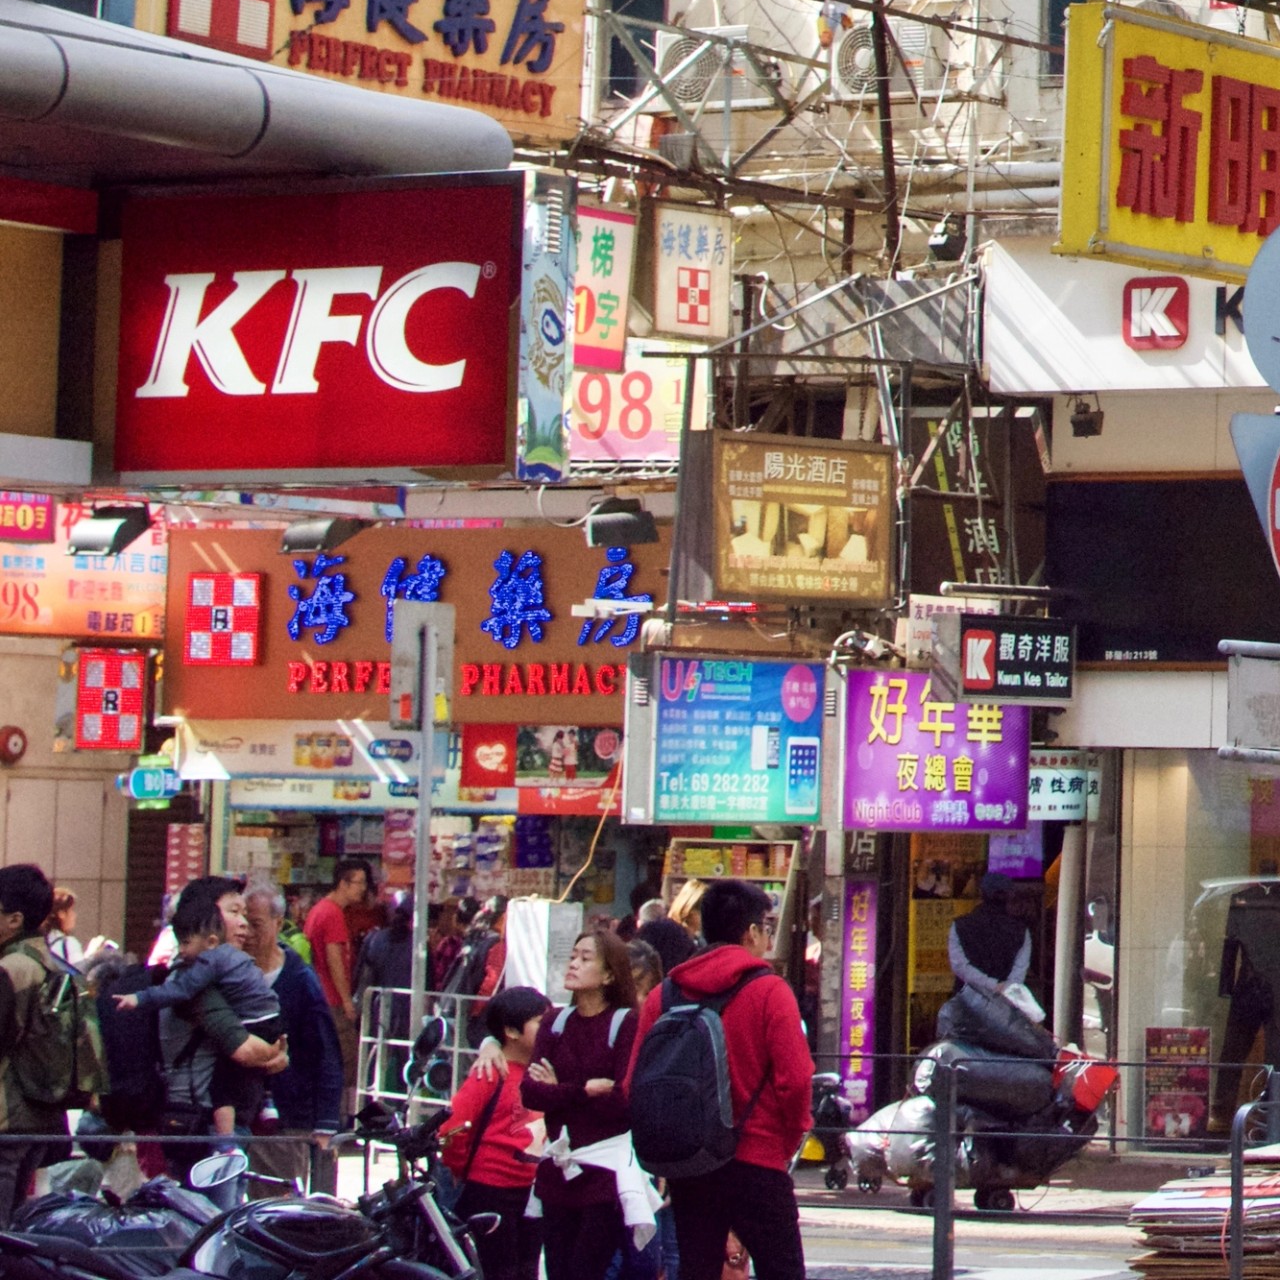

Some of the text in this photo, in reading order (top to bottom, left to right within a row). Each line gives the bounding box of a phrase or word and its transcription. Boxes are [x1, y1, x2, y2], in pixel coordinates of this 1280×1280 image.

[288, 29, 555, 118] PERFECT PHARMACY
[660, 221, 727, 265] 海健藥房
[135, 262, 481, 399] KFC
[578, 370, 653, 440] 98
[764, 452, 848, 485] 陽光酒店
[1000, 633, 1070, 663] 觀奇洋服
[702, 661, 753, 681] TECH
[998, 672, 1069, 688] Kwun Kee Tailor
[660, 772, 769, 793] Tel: 69 282 282
[897, 753, 974, 793] 夜總會
[855, 800, 890, 826] Night
[892, 803, 922, 822] Club
[850, 892, 868, 991] 好年華
